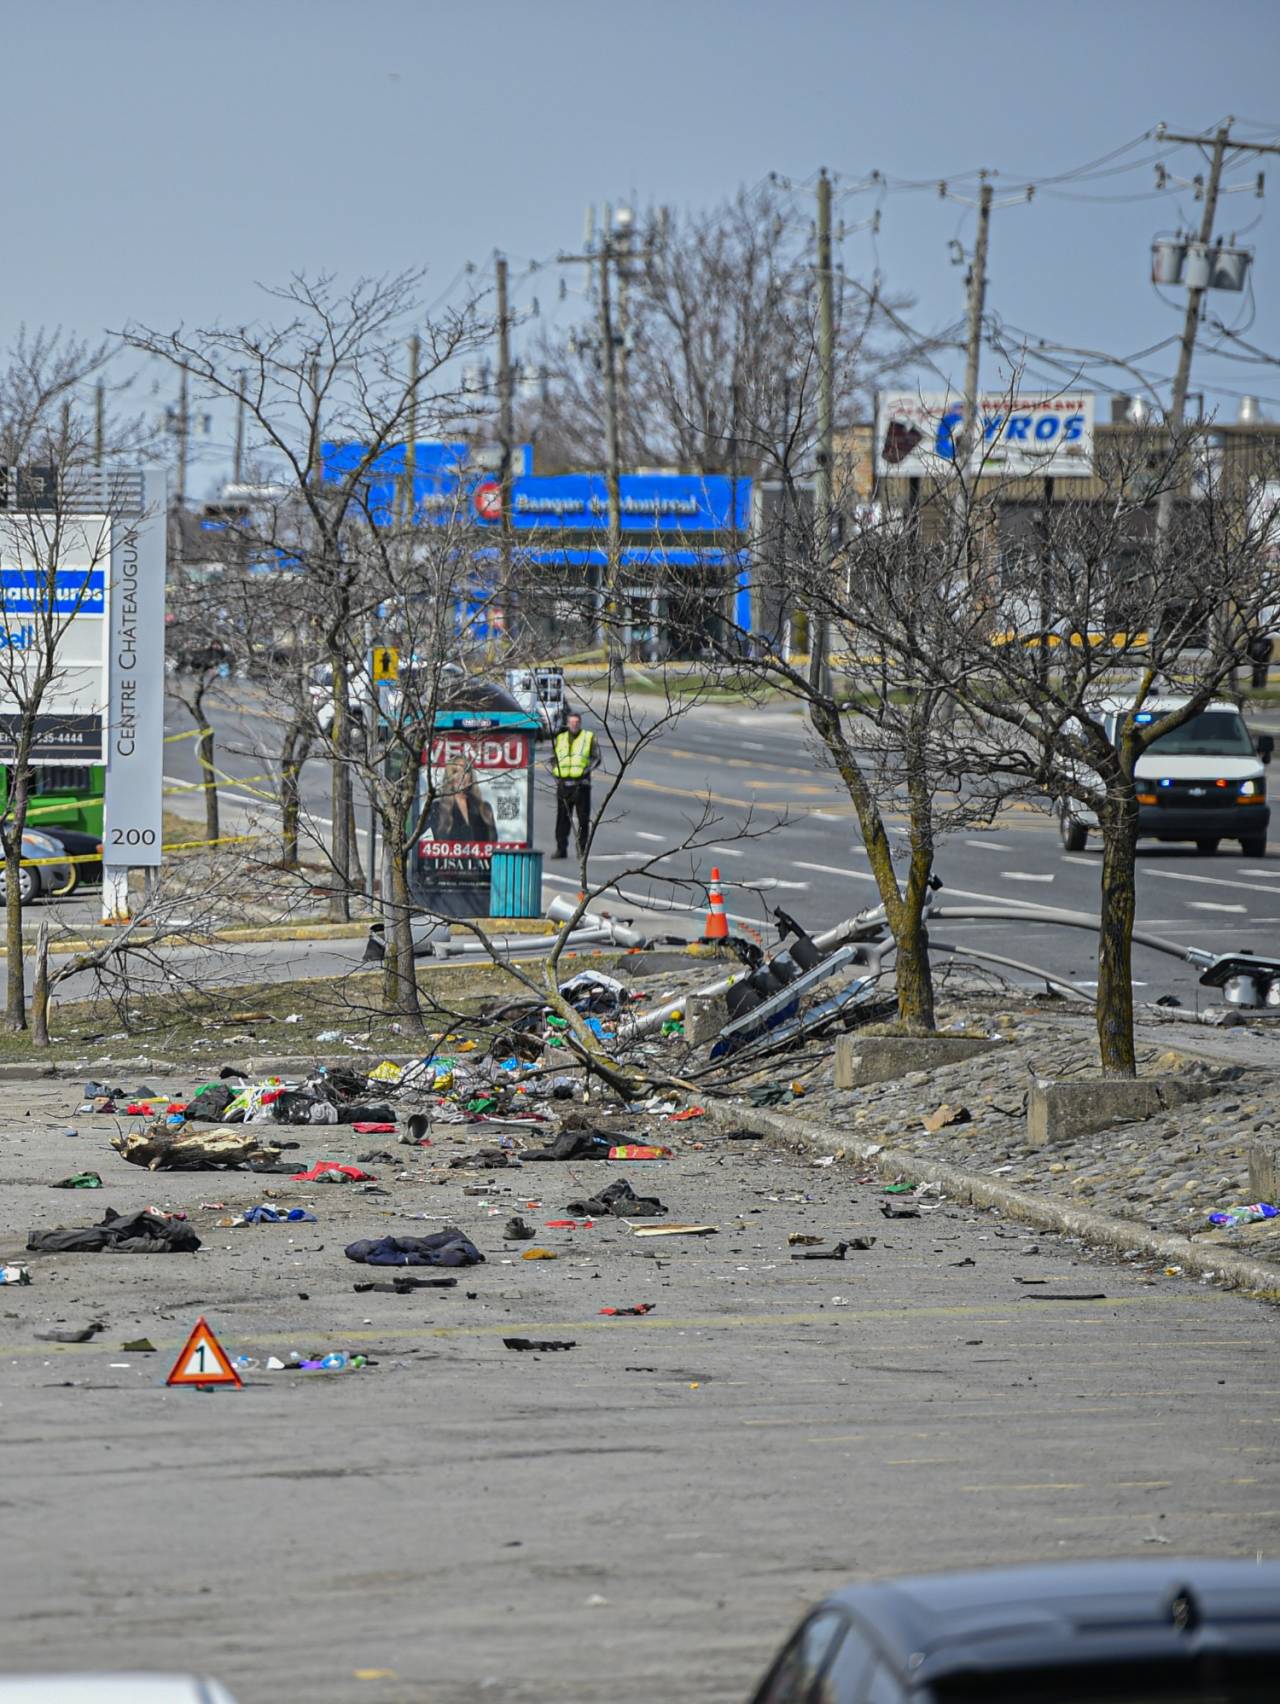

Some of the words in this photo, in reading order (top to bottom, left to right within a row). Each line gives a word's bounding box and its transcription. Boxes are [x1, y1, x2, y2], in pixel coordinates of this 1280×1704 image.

[118, 525, 139, 670] CHÂTEAUGUAY
[117, 679, 136, 757] CENTRE
[15, 732, 84, 744] 5-535-4444
[424, 740, 523, 766] VENDU
[111, 828, 156, 846] 200
[422, 843, 521, 857] 450.844.8
[195, 1345, 205, 1373] 1
